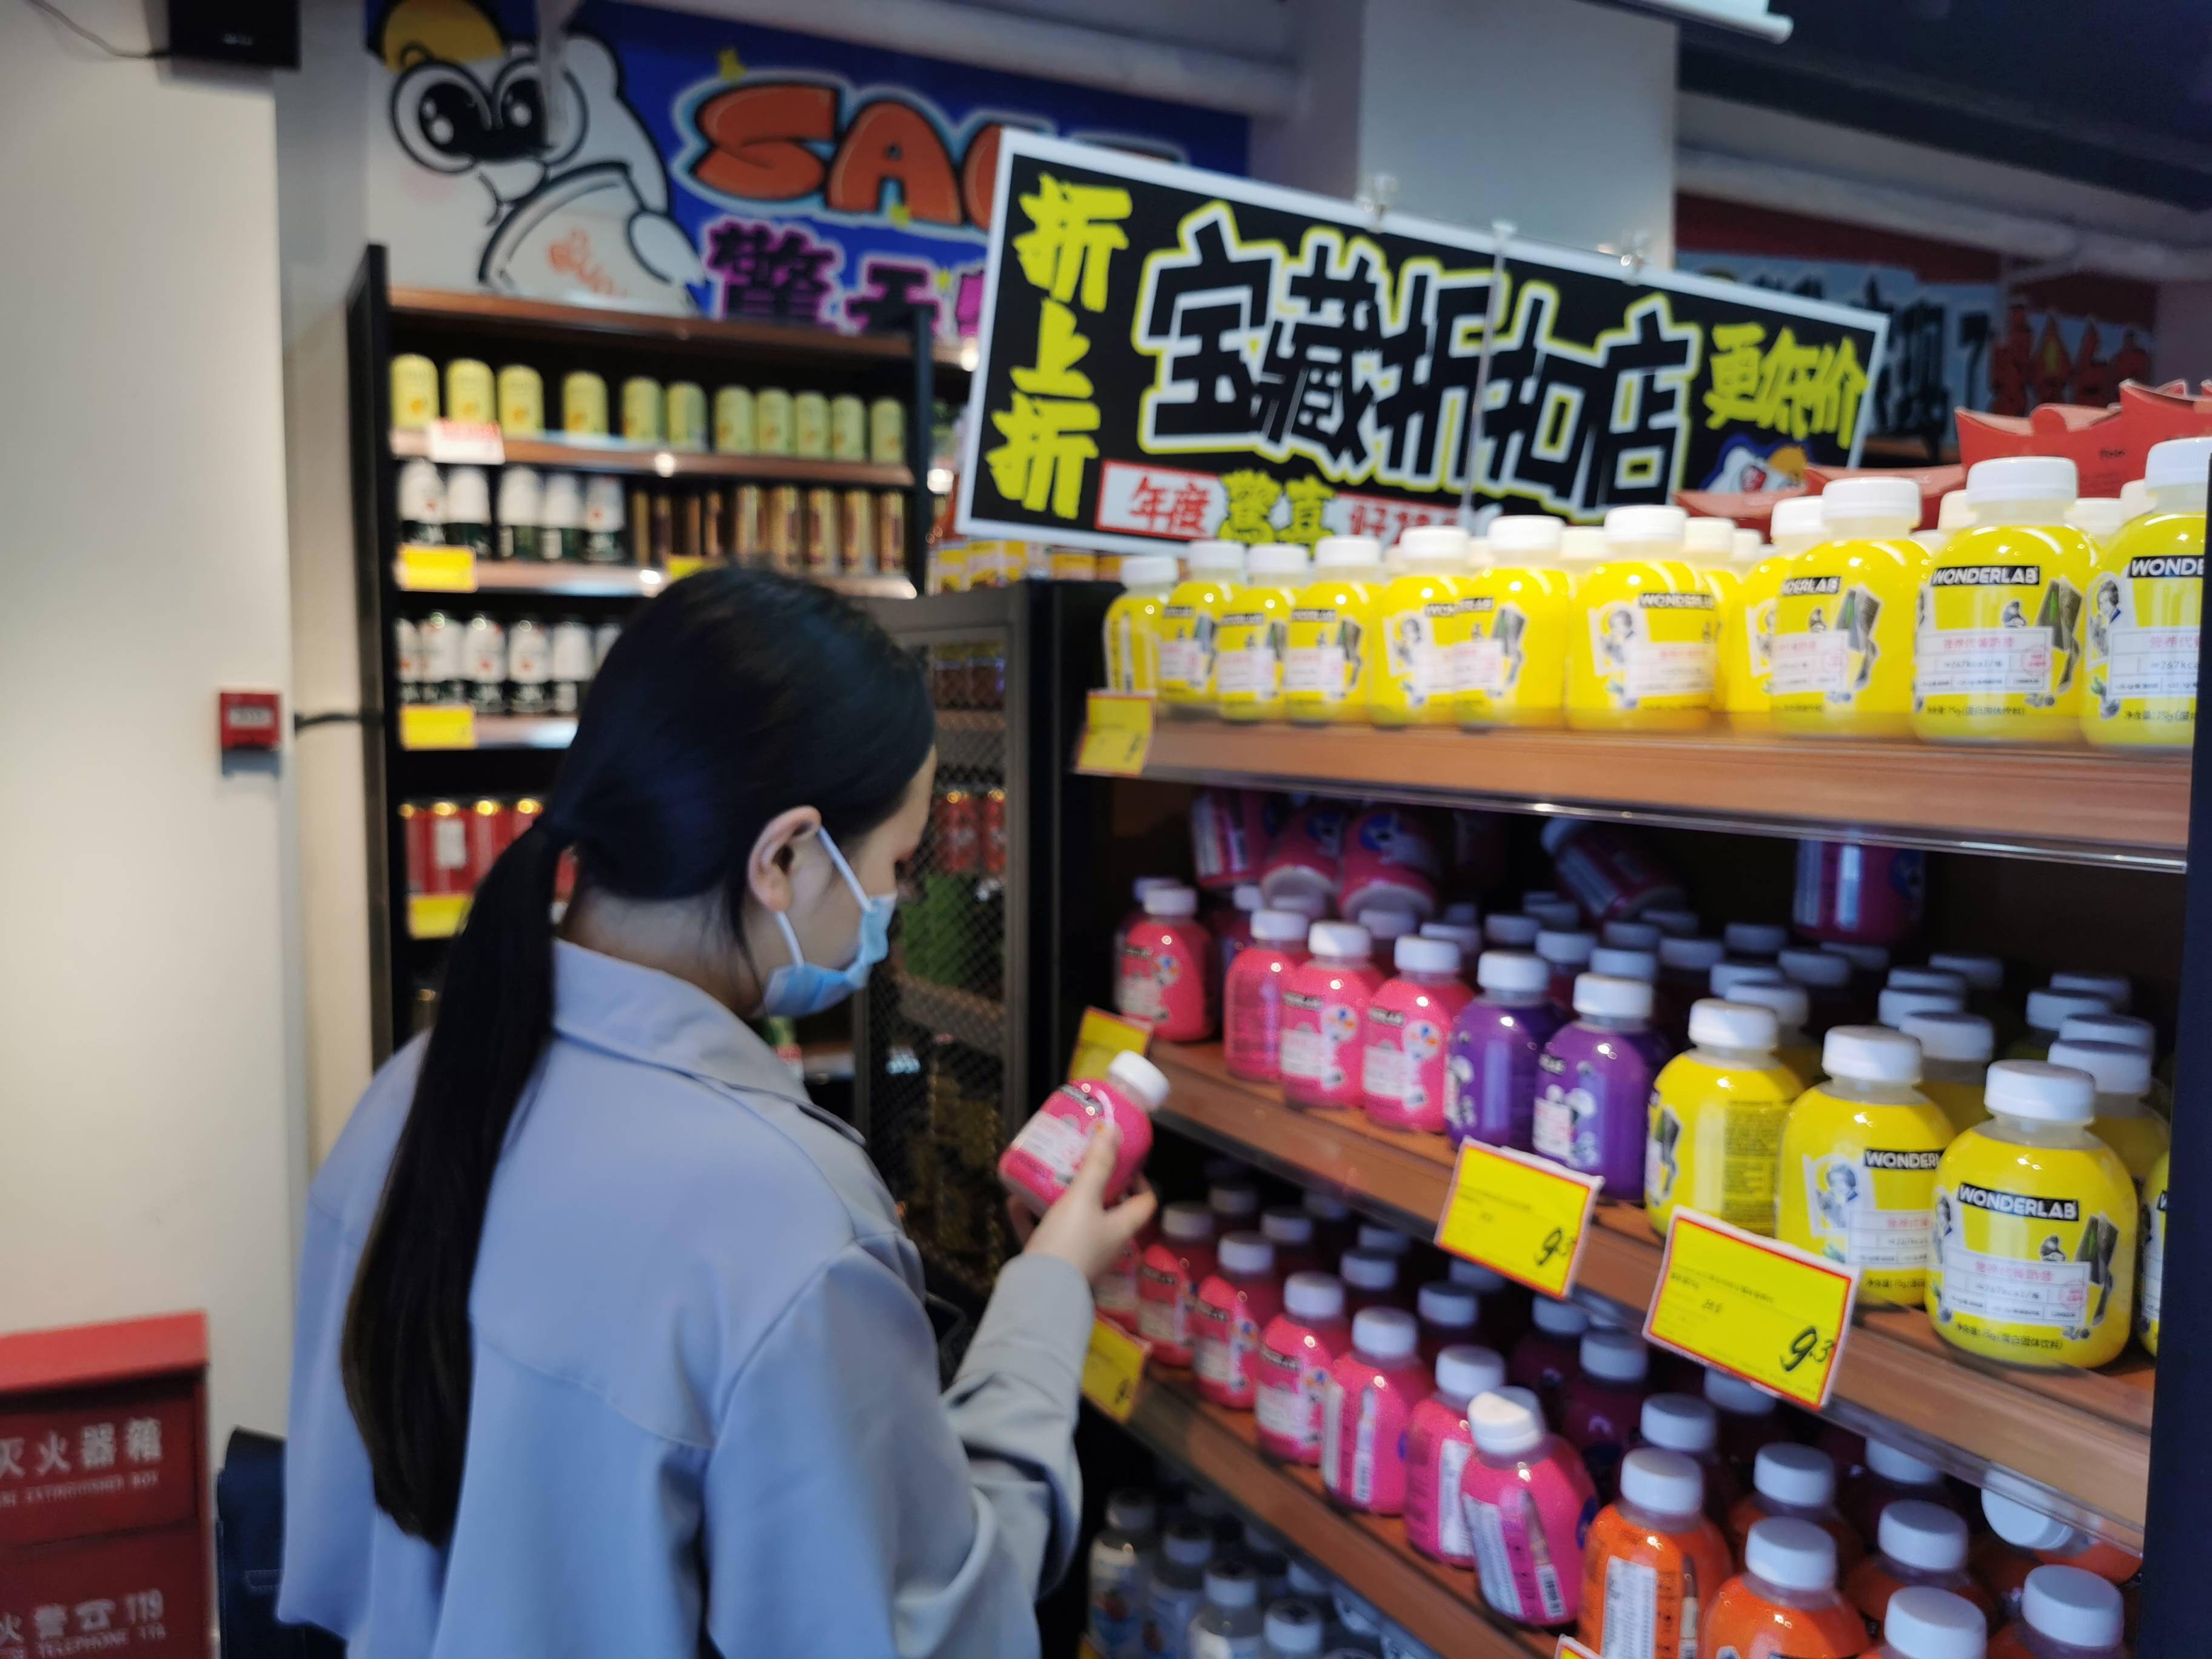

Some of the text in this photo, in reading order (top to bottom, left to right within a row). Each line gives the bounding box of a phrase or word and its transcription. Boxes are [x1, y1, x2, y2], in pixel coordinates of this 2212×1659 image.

[985, 172, 1133, 519] 折上折
[1135, 205, 1700, 520] 宝藏折扣店
[1933, 568, 2039, 585] WONDERLAB
[1960, 1184, 2078, 1219] WONDERLAB
[126, 1589, 164, 1624] 119
